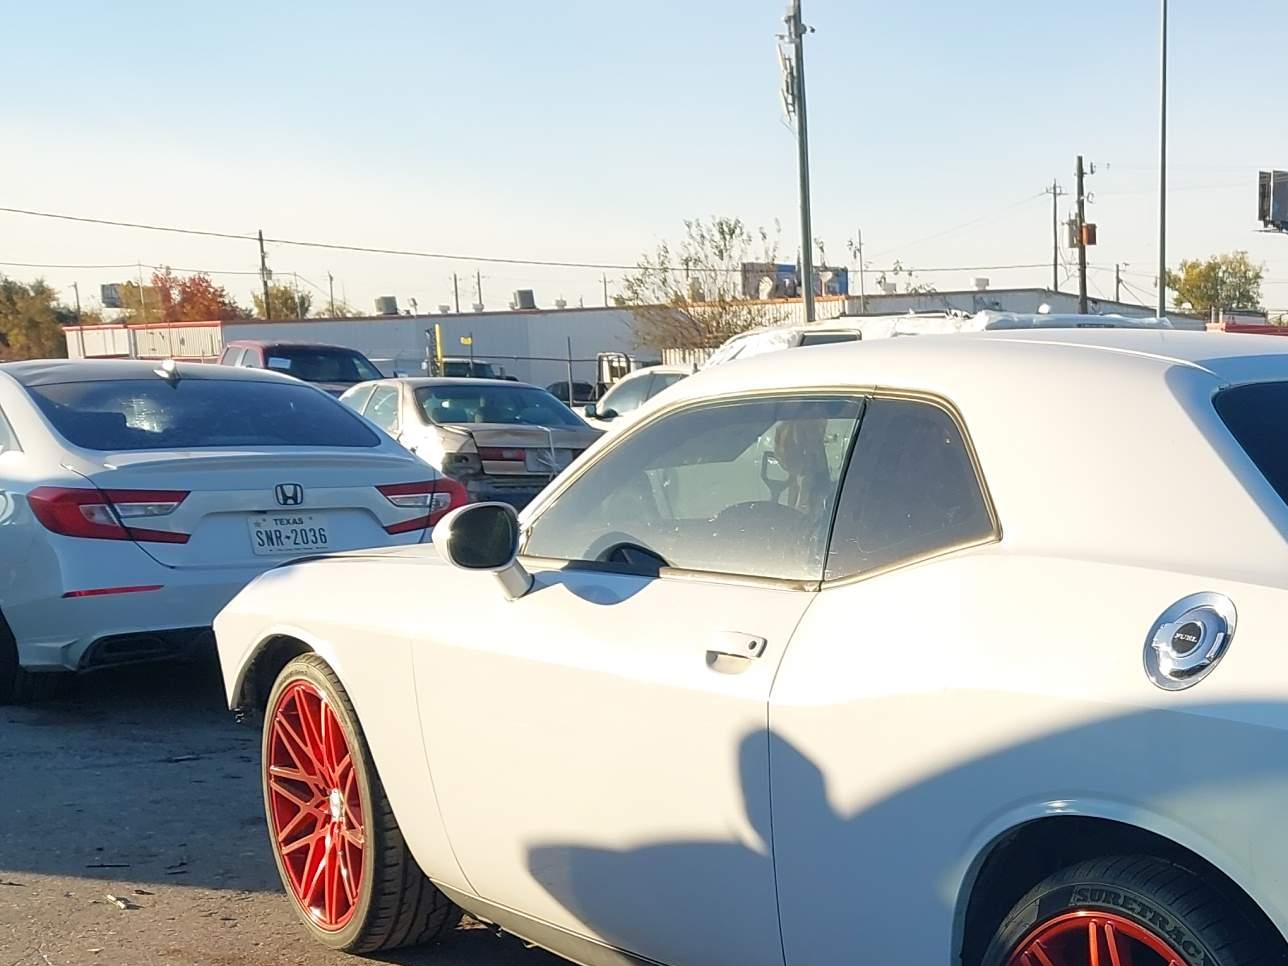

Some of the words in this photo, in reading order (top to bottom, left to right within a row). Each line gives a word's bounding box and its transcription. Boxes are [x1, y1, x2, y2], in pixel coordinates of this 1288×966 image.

[273, 518, 304, 526] TEXAS
[1174, 632, 1198, 643] FUEL
[1074, 886, 1206, 960] SURETRAC
